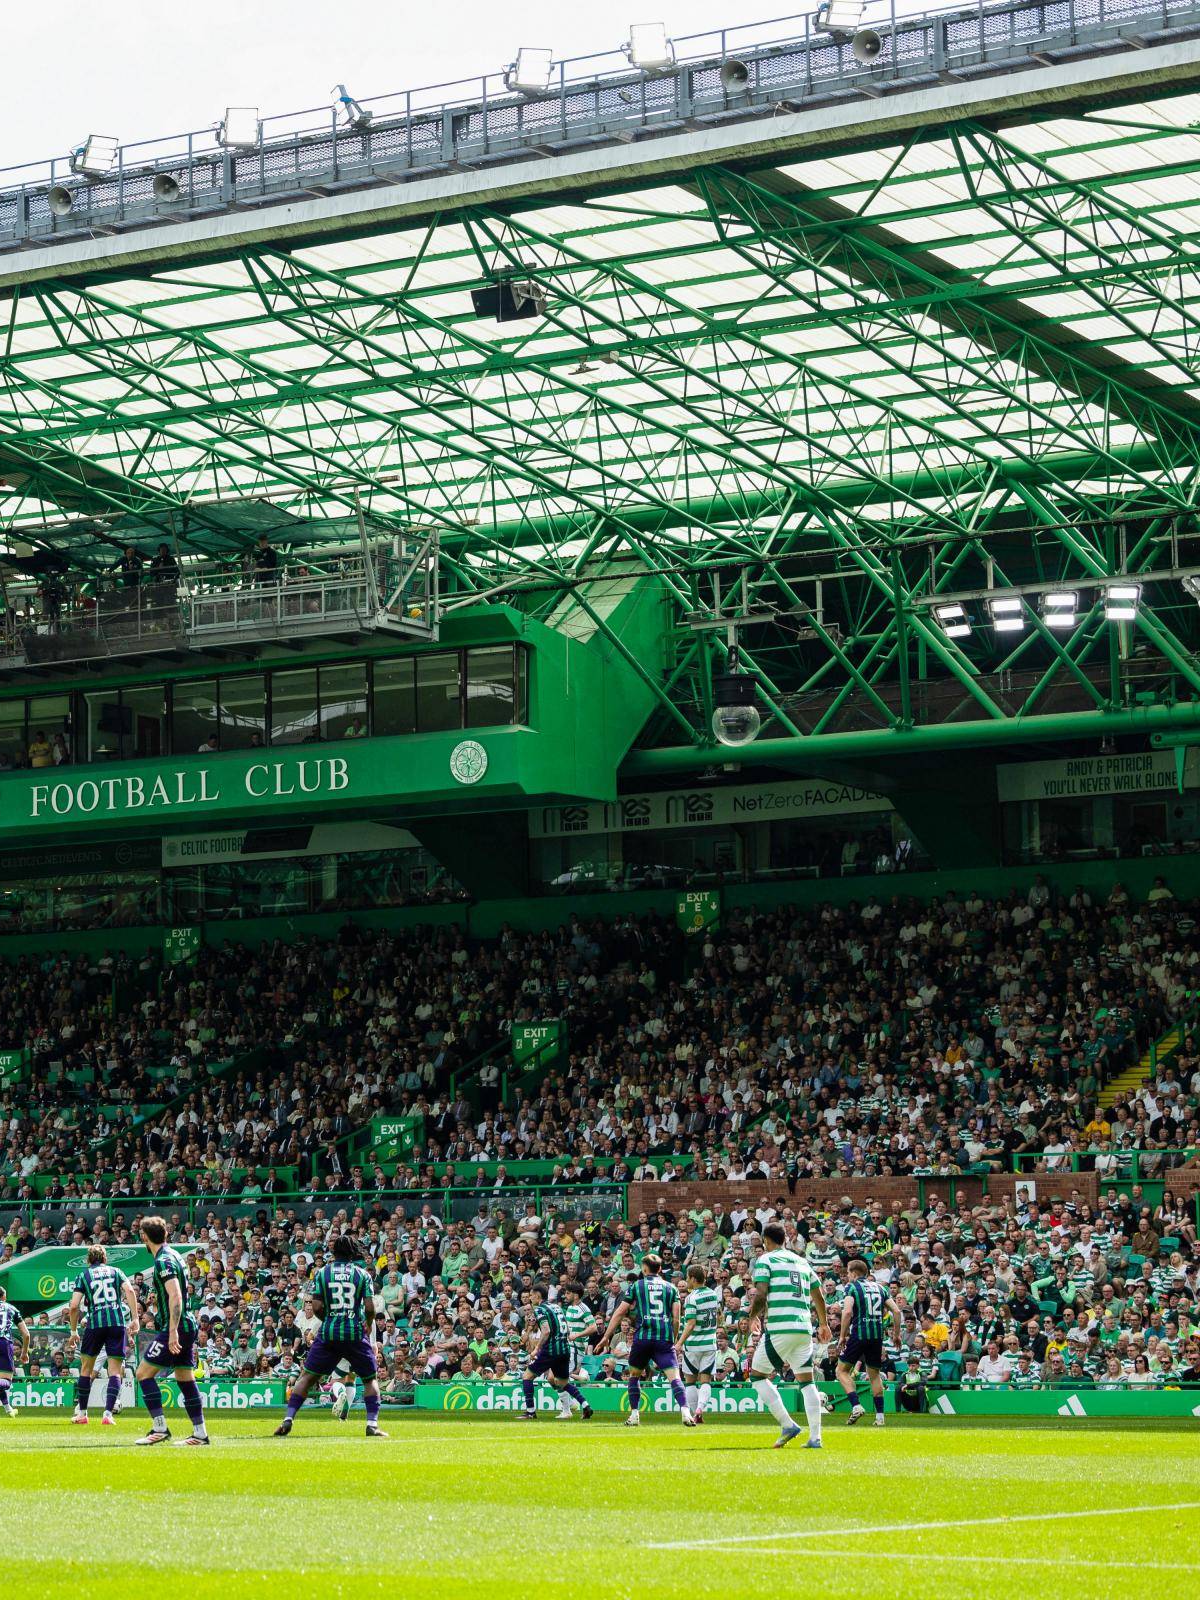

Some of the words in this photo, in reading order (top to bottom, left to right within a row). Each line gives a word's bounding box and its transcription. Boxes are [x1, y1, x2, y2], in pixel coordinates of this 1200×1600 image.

[1067, 760, 1094, 777] ANDY
[1096, 758, 1104, 774] &
[1106, 756, 1153, 773] PATRICIA
[29, 769, 220, 817] FOOTBALL
[245, 758, 350, 797] CLUB
[1043, 779, 1076, 795] YOU'LL
[1080, 776, 1111, 793] NEVER
[1113, 774, 1142, 791] WALK
[1145, 771, 1177, 788] ALONE
[181, 839, 208, 856] CELTIC
[210, 836, 245, 853] FOOTBA
[687, 892, 710, 903] EXIT
[695, 902, 701, 912] E
[172, 928, 192, 937] EXIT
[178, 938, 186, 946] C
[523, 1028, 548, 1039] EXIT
[532, 1039, 539, 1048] F
[380, 1123, 406, 1135] EXIT
[90, 1278, 116, 1304] 26
[789, 1271, 802, 1298] 9
[328, 1282, 355, 1309] 33
[650, 1291, 664, 1314] 5
[865, 1293, 882, 1316] 12
[148, 1341, 164, 1357] 15
